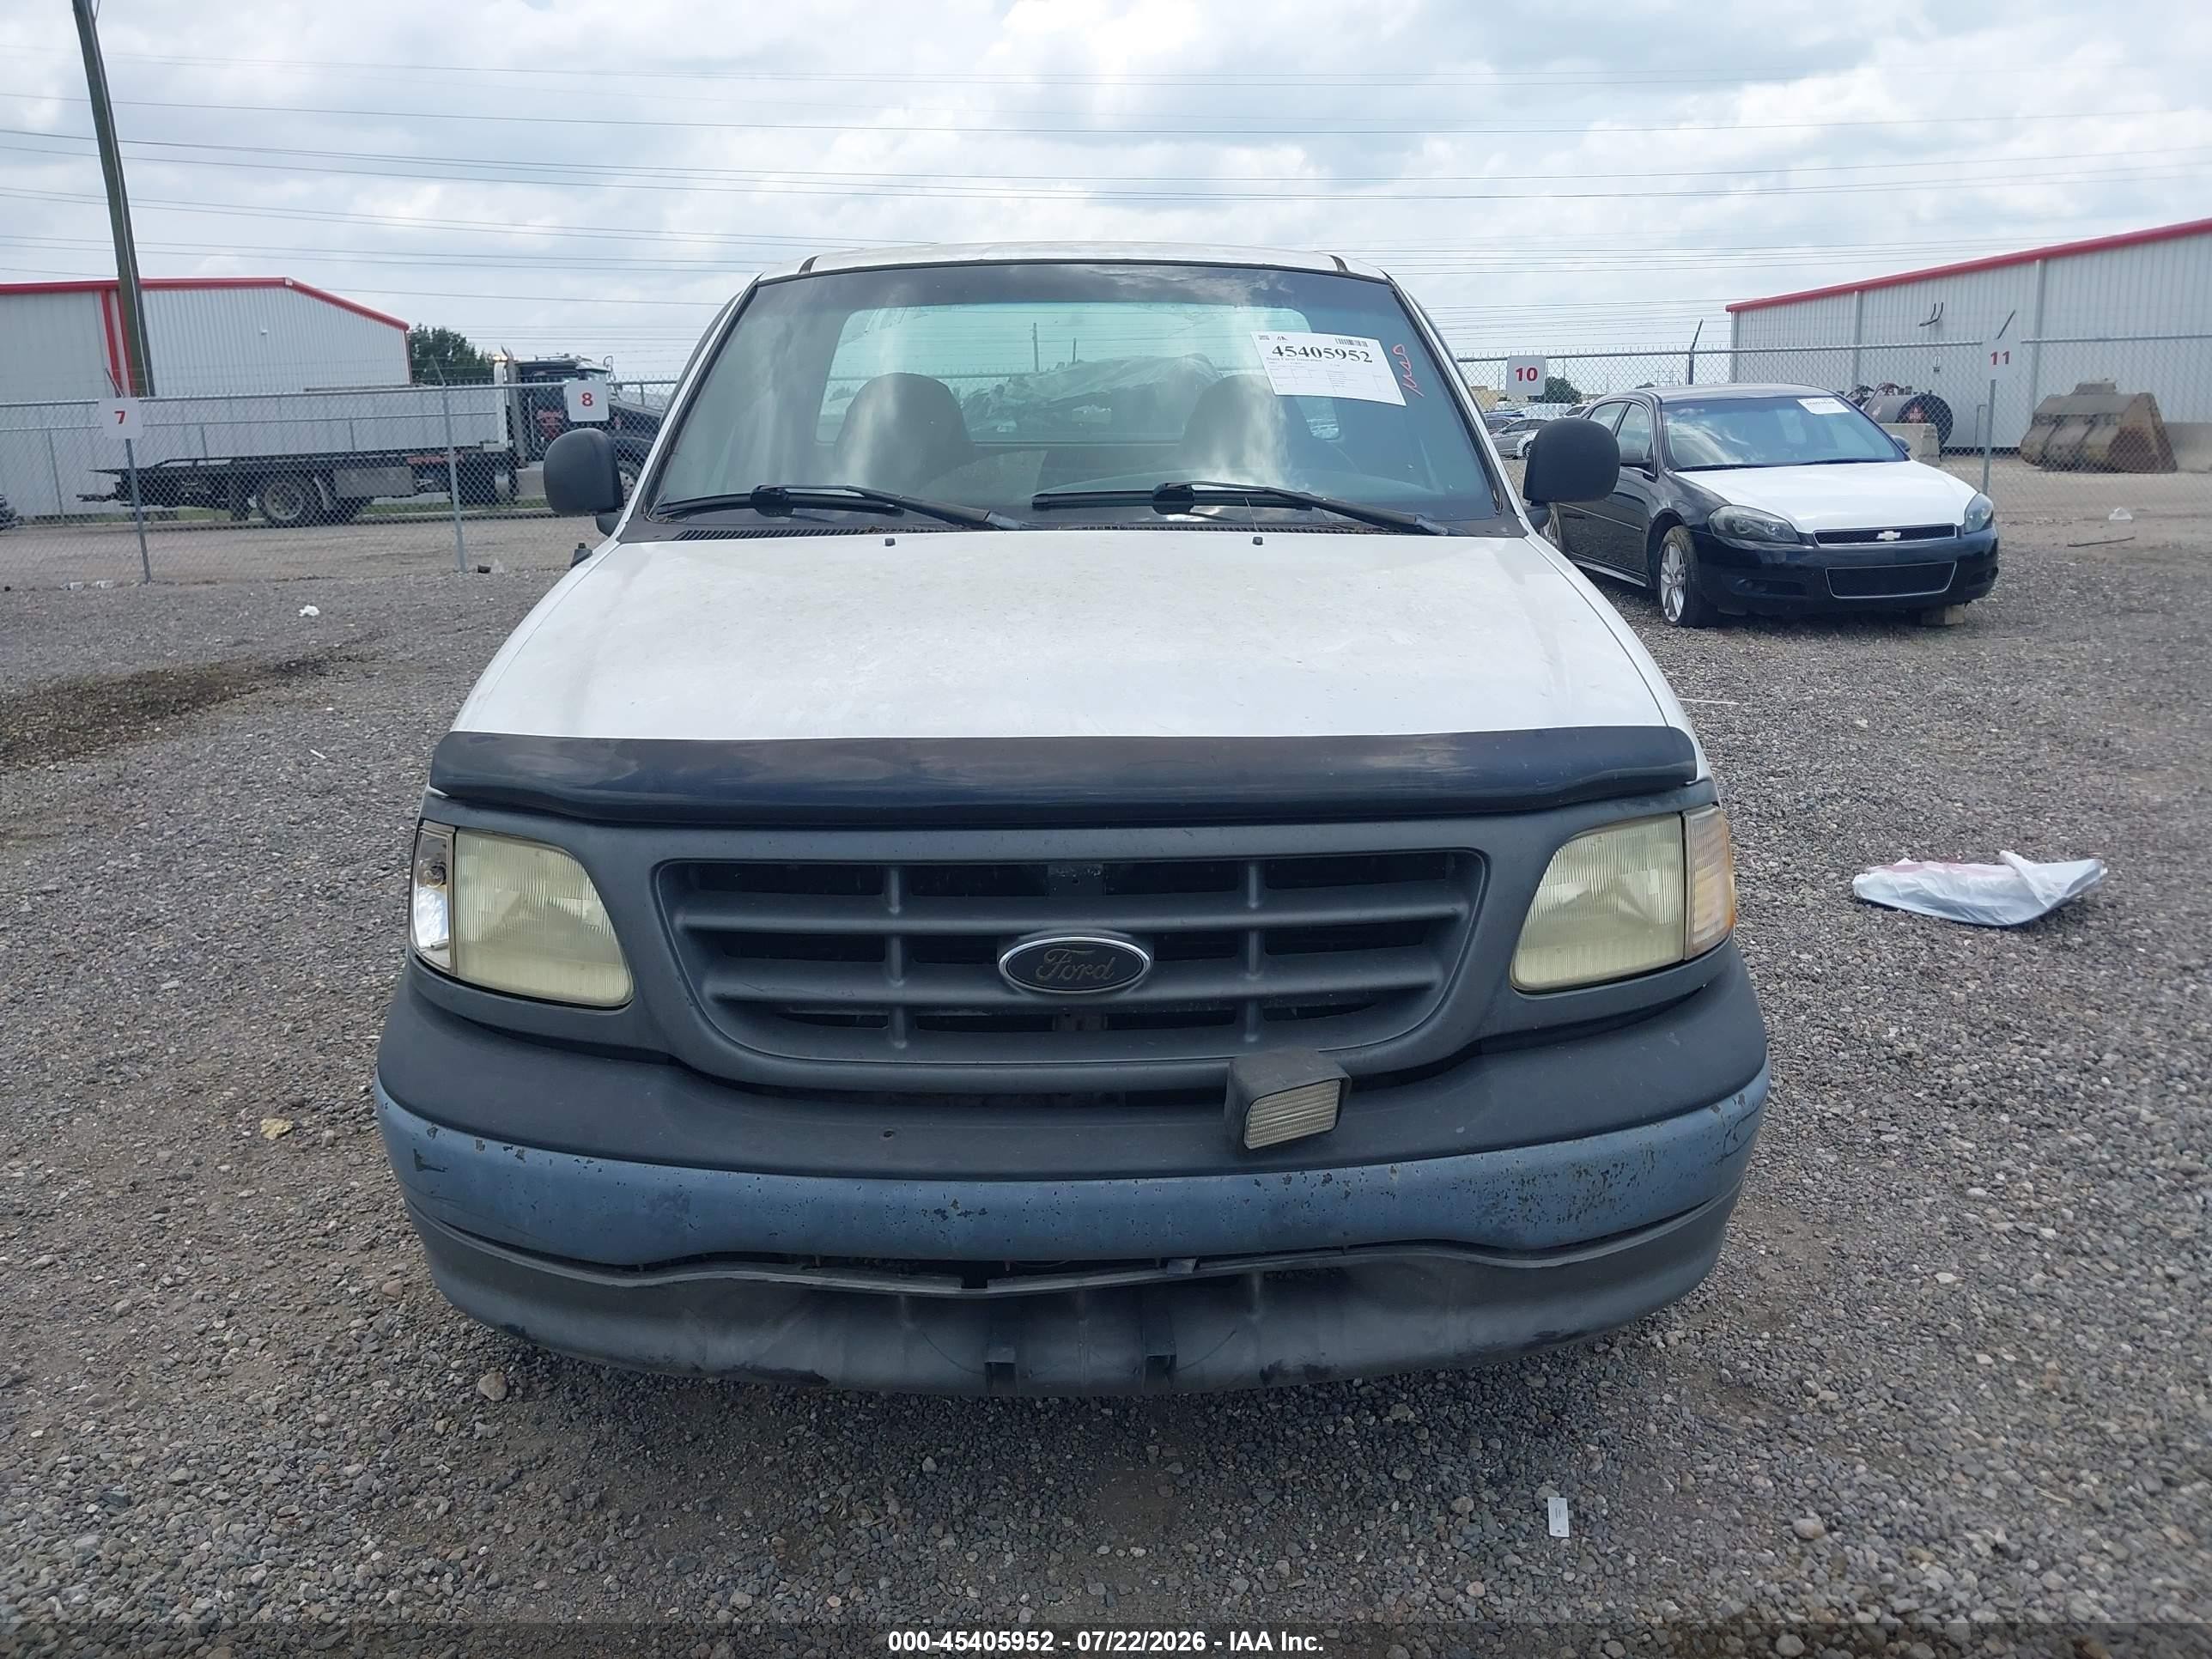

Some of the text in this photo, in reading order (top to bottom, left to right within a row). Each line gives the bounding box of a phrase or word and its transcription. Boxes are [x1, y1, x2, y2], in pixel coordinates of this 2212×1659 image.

[1272, 345, 1373, 363] 45405952
[1990, 350, 2010, 365] 11
[1516, 367, 1538, 381] 10
[581, 392, 593, 406] 8
[114, 410, 125, 424] 7
[1036, 948, 1116, 981] Ford
